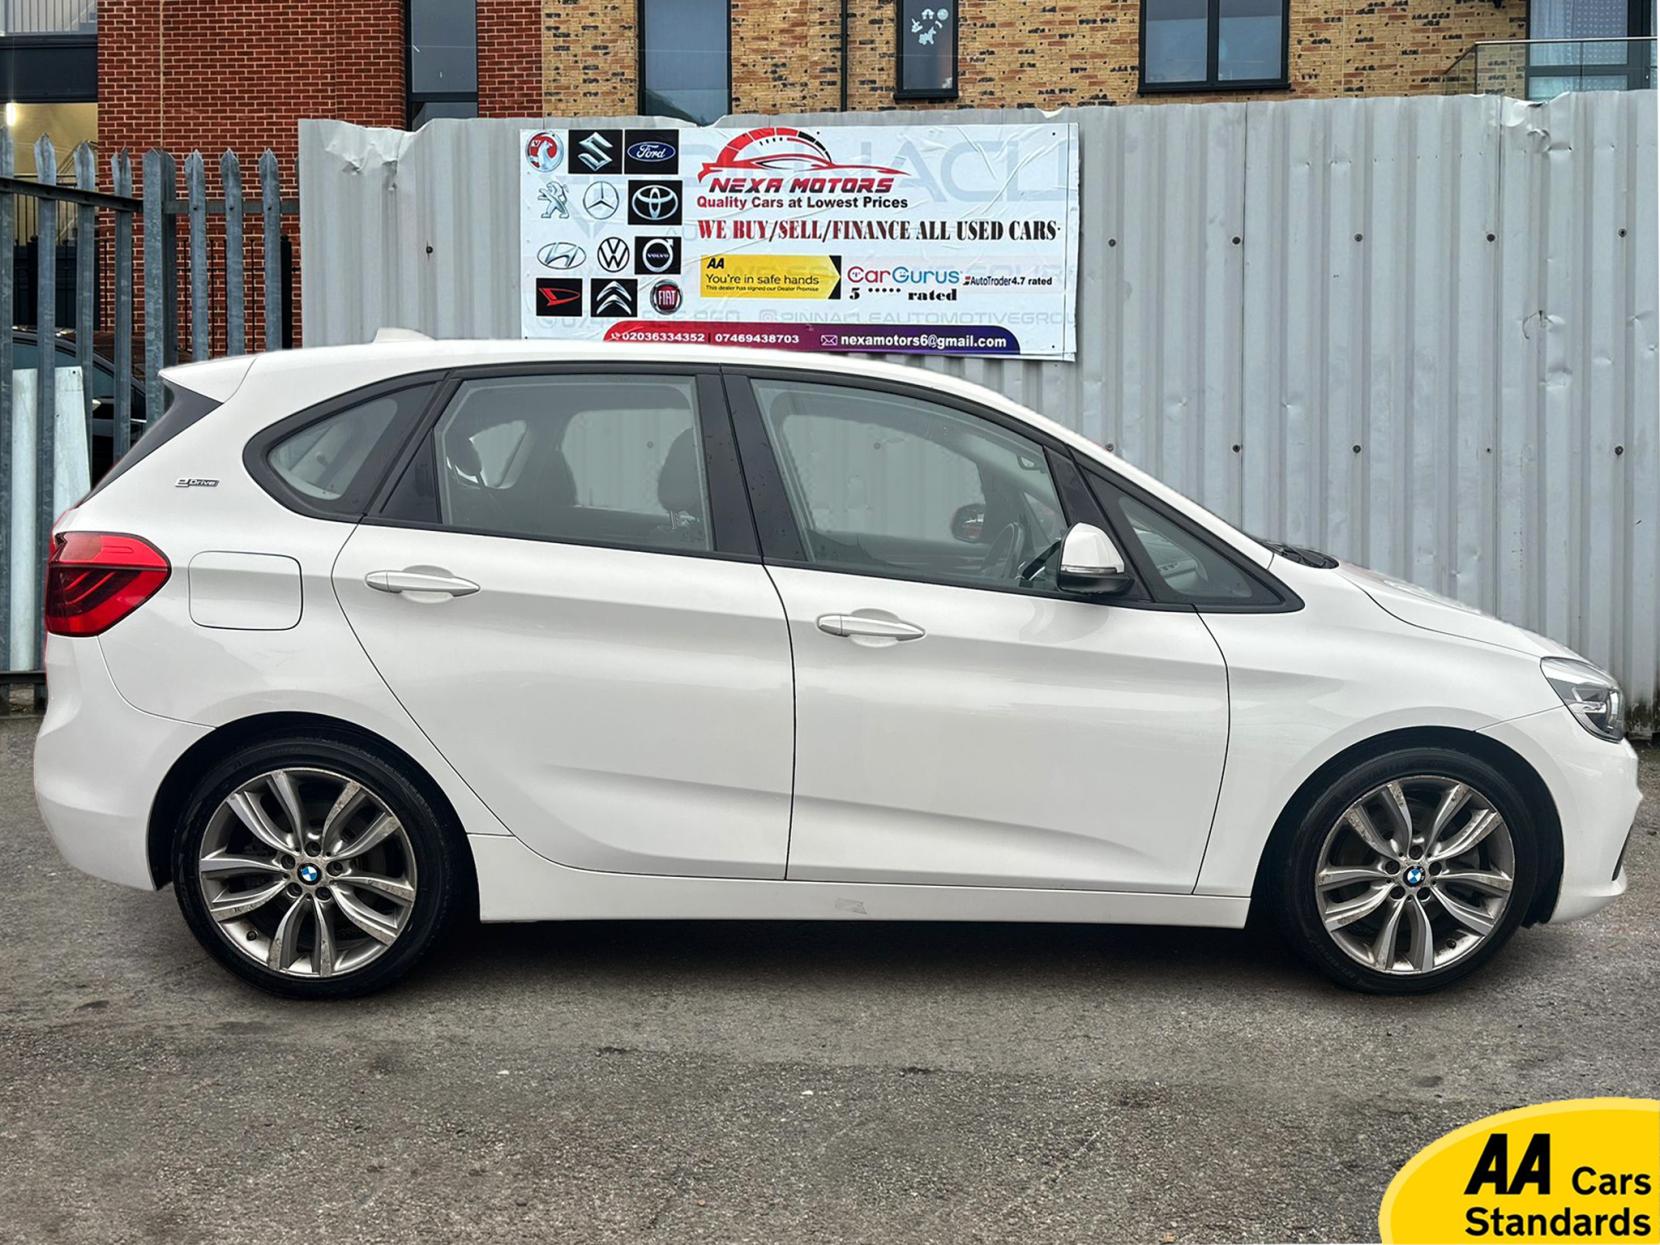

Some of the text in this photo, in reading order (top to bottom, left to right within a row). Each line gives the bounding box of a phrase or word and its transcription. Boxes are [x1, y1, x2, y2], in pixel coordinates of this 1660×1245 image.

[637, 144, 666, 158] Ford
[709, 178, 895, 193] NEXA MOTORS
[697, 196, 908, 210] Quality Cars at Lowest Prices
[698, 220, 727, 239] WE
[916, 220, 950, 240] ALL
[956, 220, 1004, 240] USED
[706, 257, 725, 269] AA
[705, 274, 820, 285] You're in safe hands
[847, 266, 960, 284] CarGurus
[1028, 277, 1053, 285] rated
[658, 290, 676, 305] FIAT
[849, 287, 958, 301] 5 rated
[622, 332, 799, 344] 02036334352 07469438703
[841, 334, 1007, 349] nexamotors6@gmail.com
